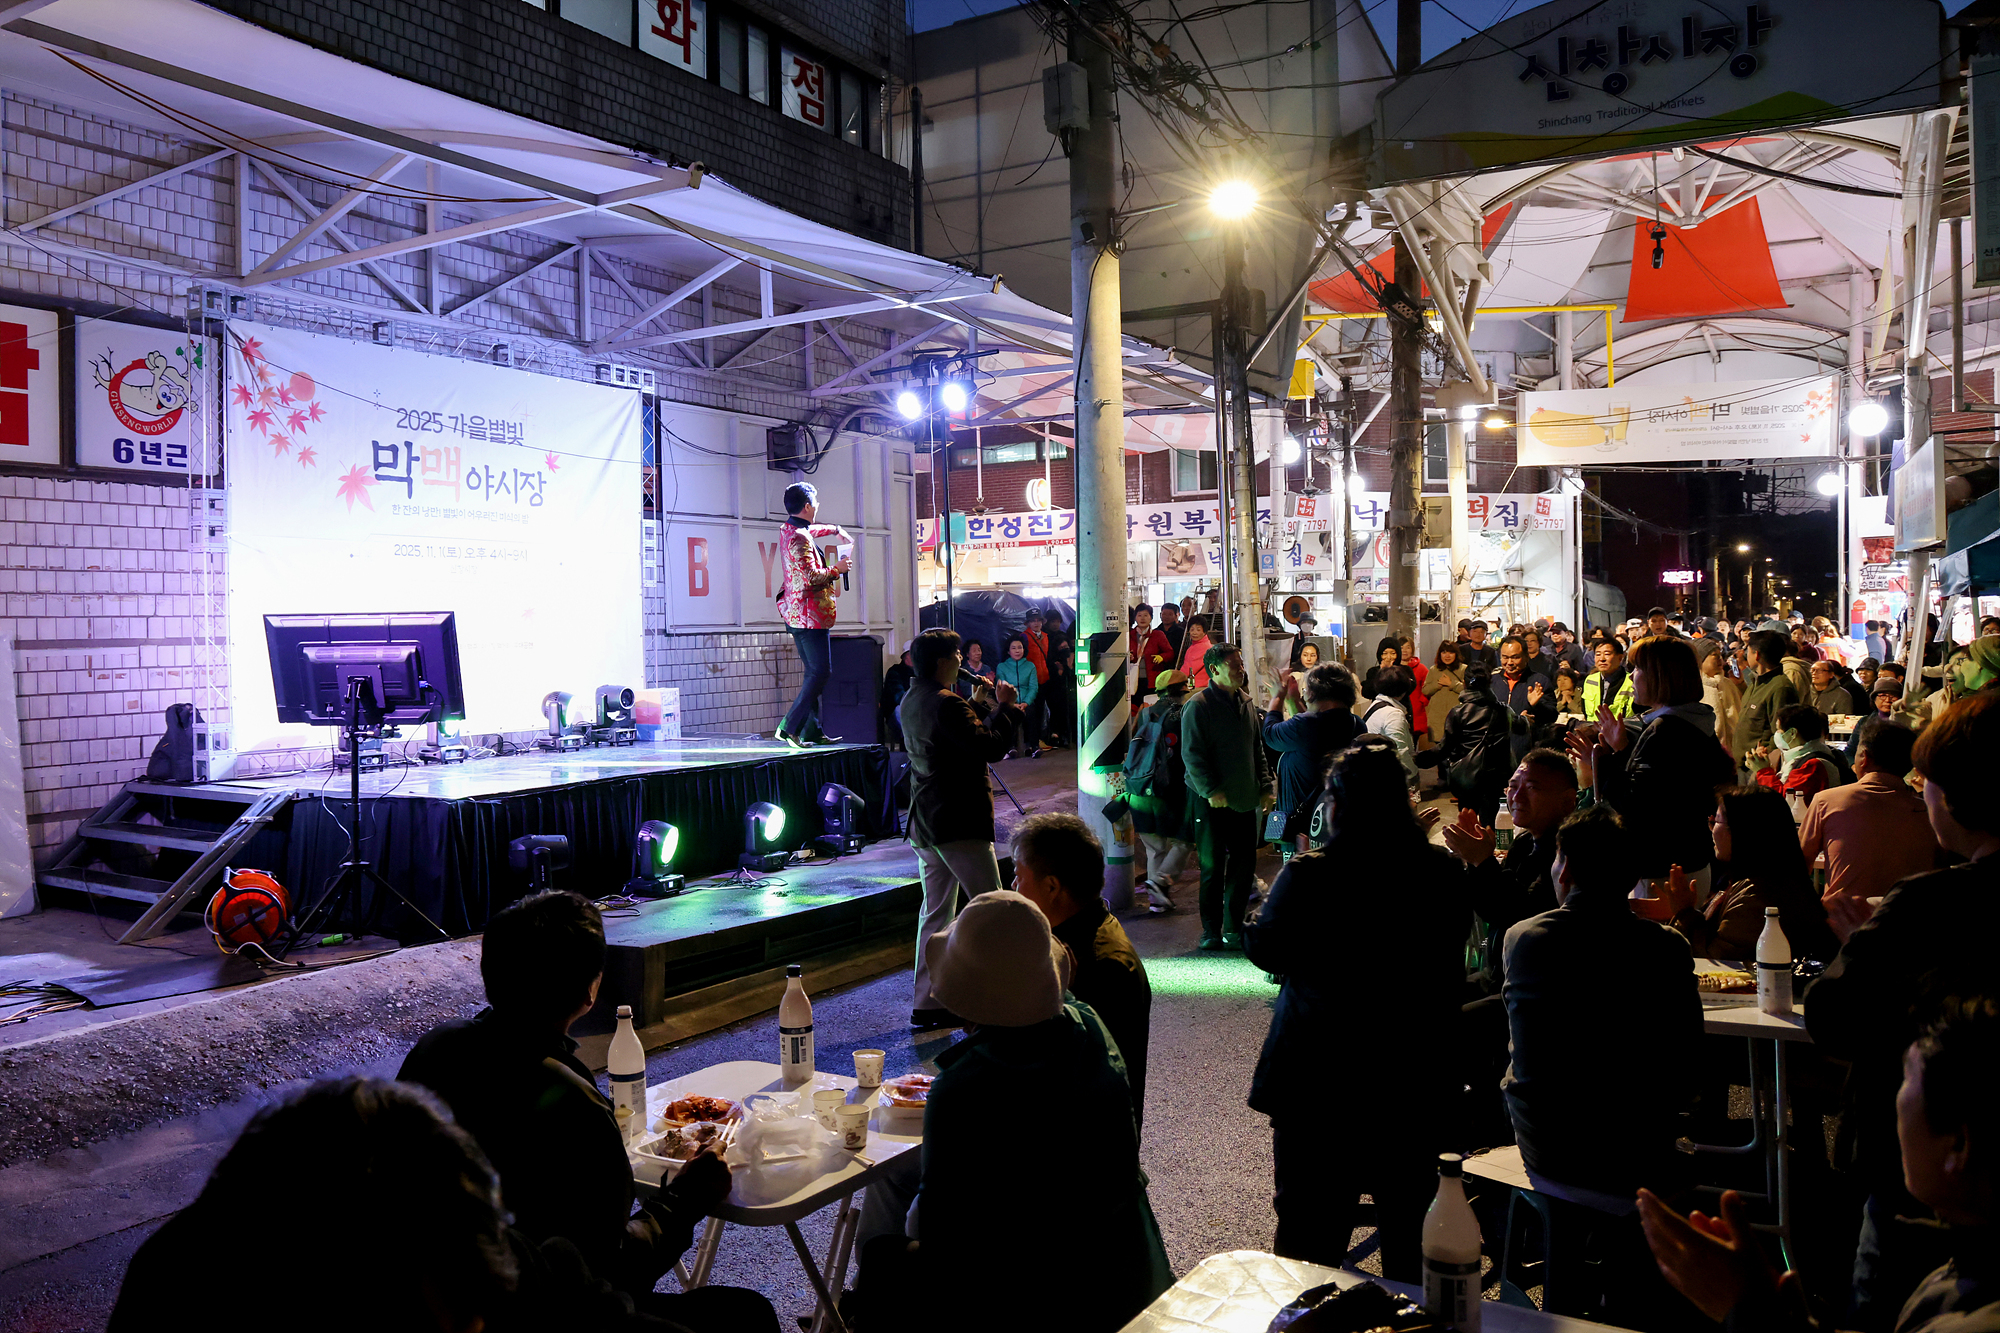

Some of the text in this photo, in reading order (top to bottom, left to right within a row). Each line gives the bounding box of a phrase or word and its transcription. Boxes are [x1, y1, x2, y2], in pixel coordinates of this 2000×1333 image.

[1518, 4, 1773, 102] 신창시장
[791, 56, 825, 127] 점
[1538, 95, 1706, 129] Shinchang Traditional Markets
[397, 408, 524, 446] 2025 가을별빛
[113, 438, 187, 467] 6년근
[372, 440, 547, 507] 막맥 야시장
[391, 504, 401, 516] 한
[403, 505, 420, 516] 잔의
[1287, 519, 1328, 532] 90-7797
[1523, 518, 1564, 529] 93-7797
[464, 547, 487, 560] 오후
